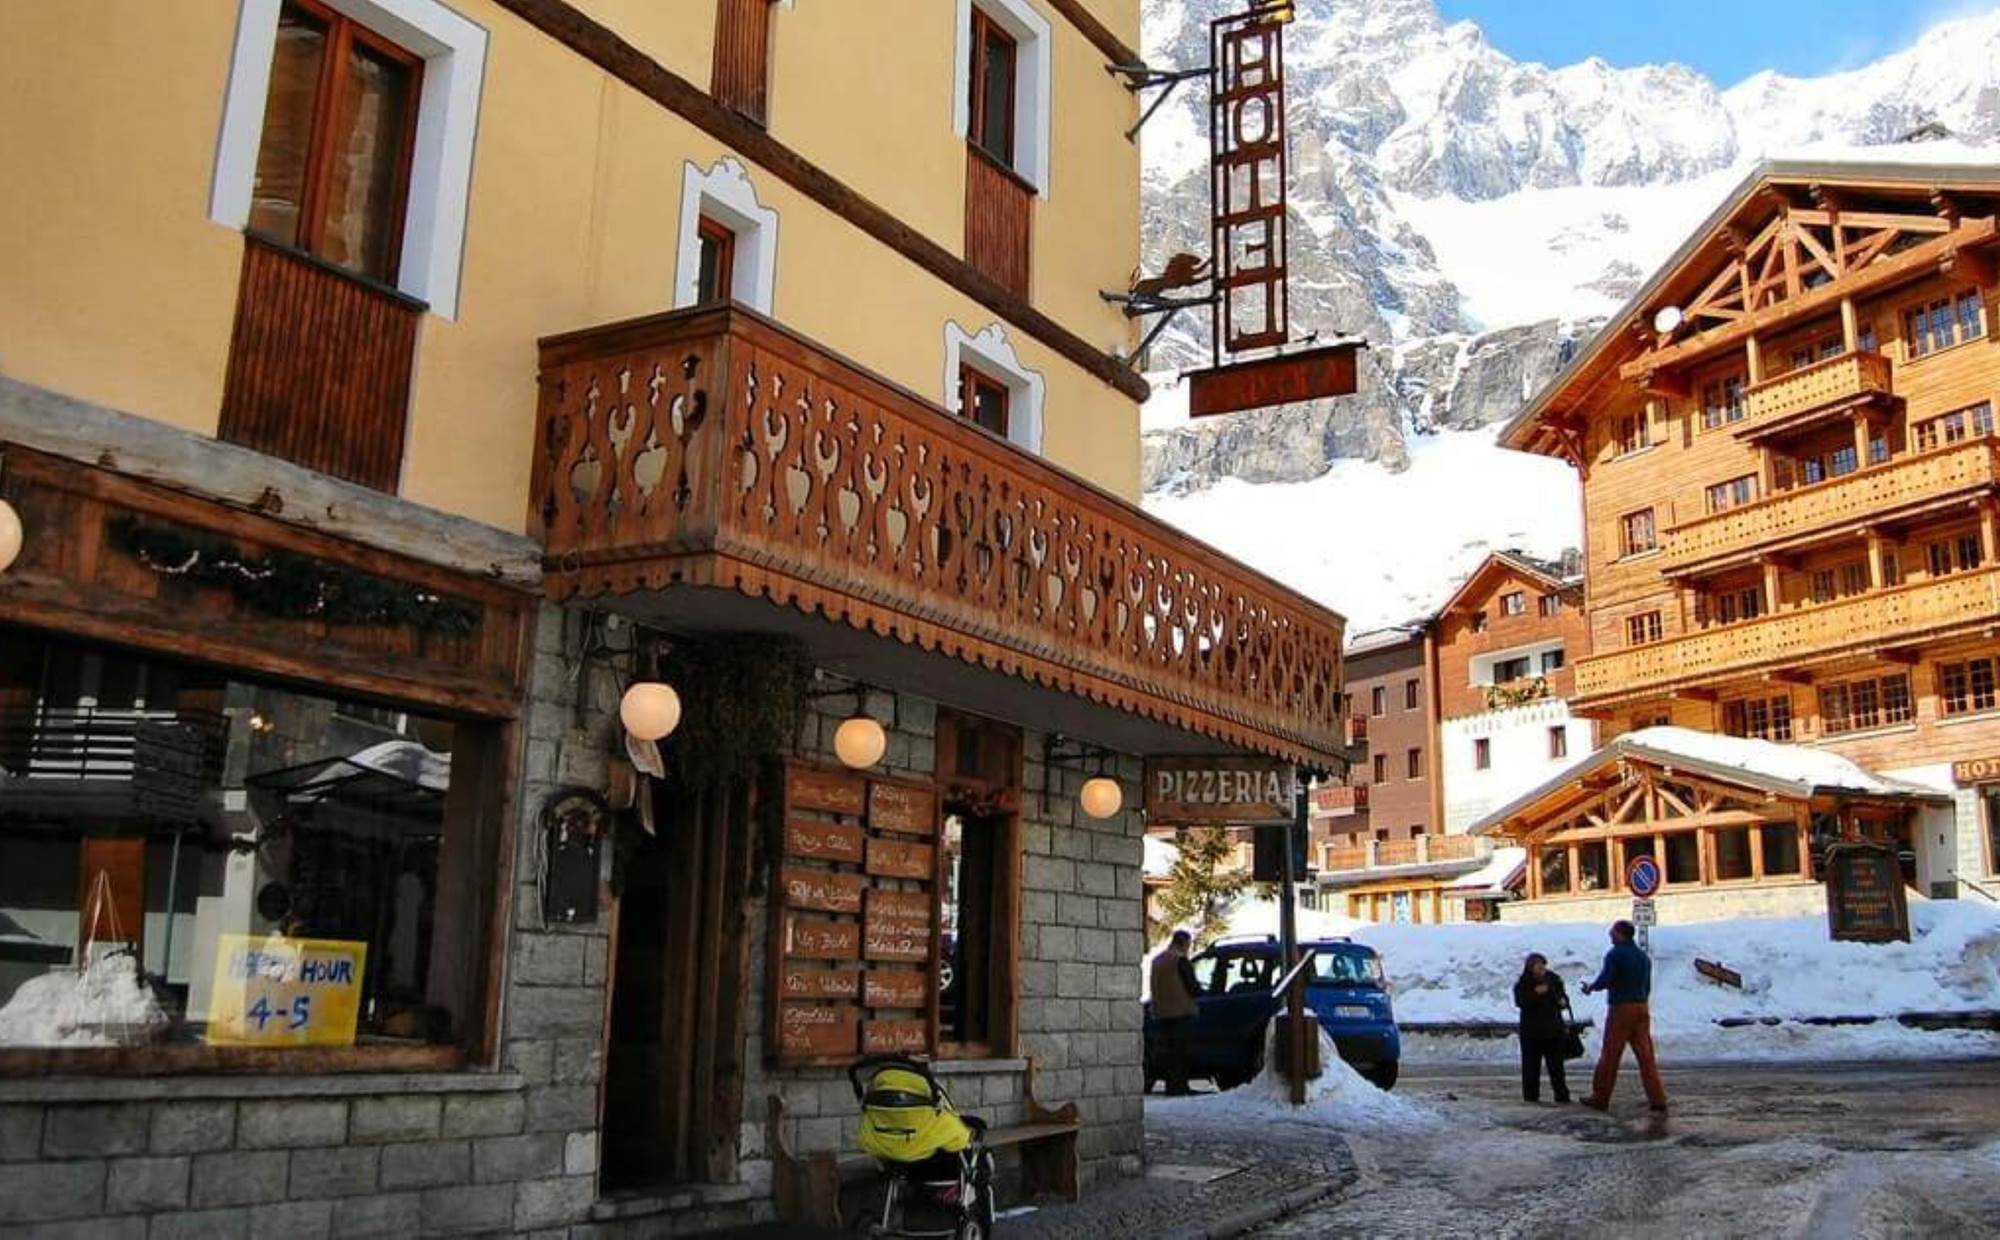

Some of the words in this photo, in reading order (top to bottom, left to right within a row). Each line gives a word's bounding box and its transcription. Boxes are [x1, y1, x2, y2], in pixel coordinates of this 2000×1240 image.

[1157, 769, 1282, 804] PIZZERIA
[300, 958, 353, 985] HOUR
[248, 996, 310, 1031] 4-5
